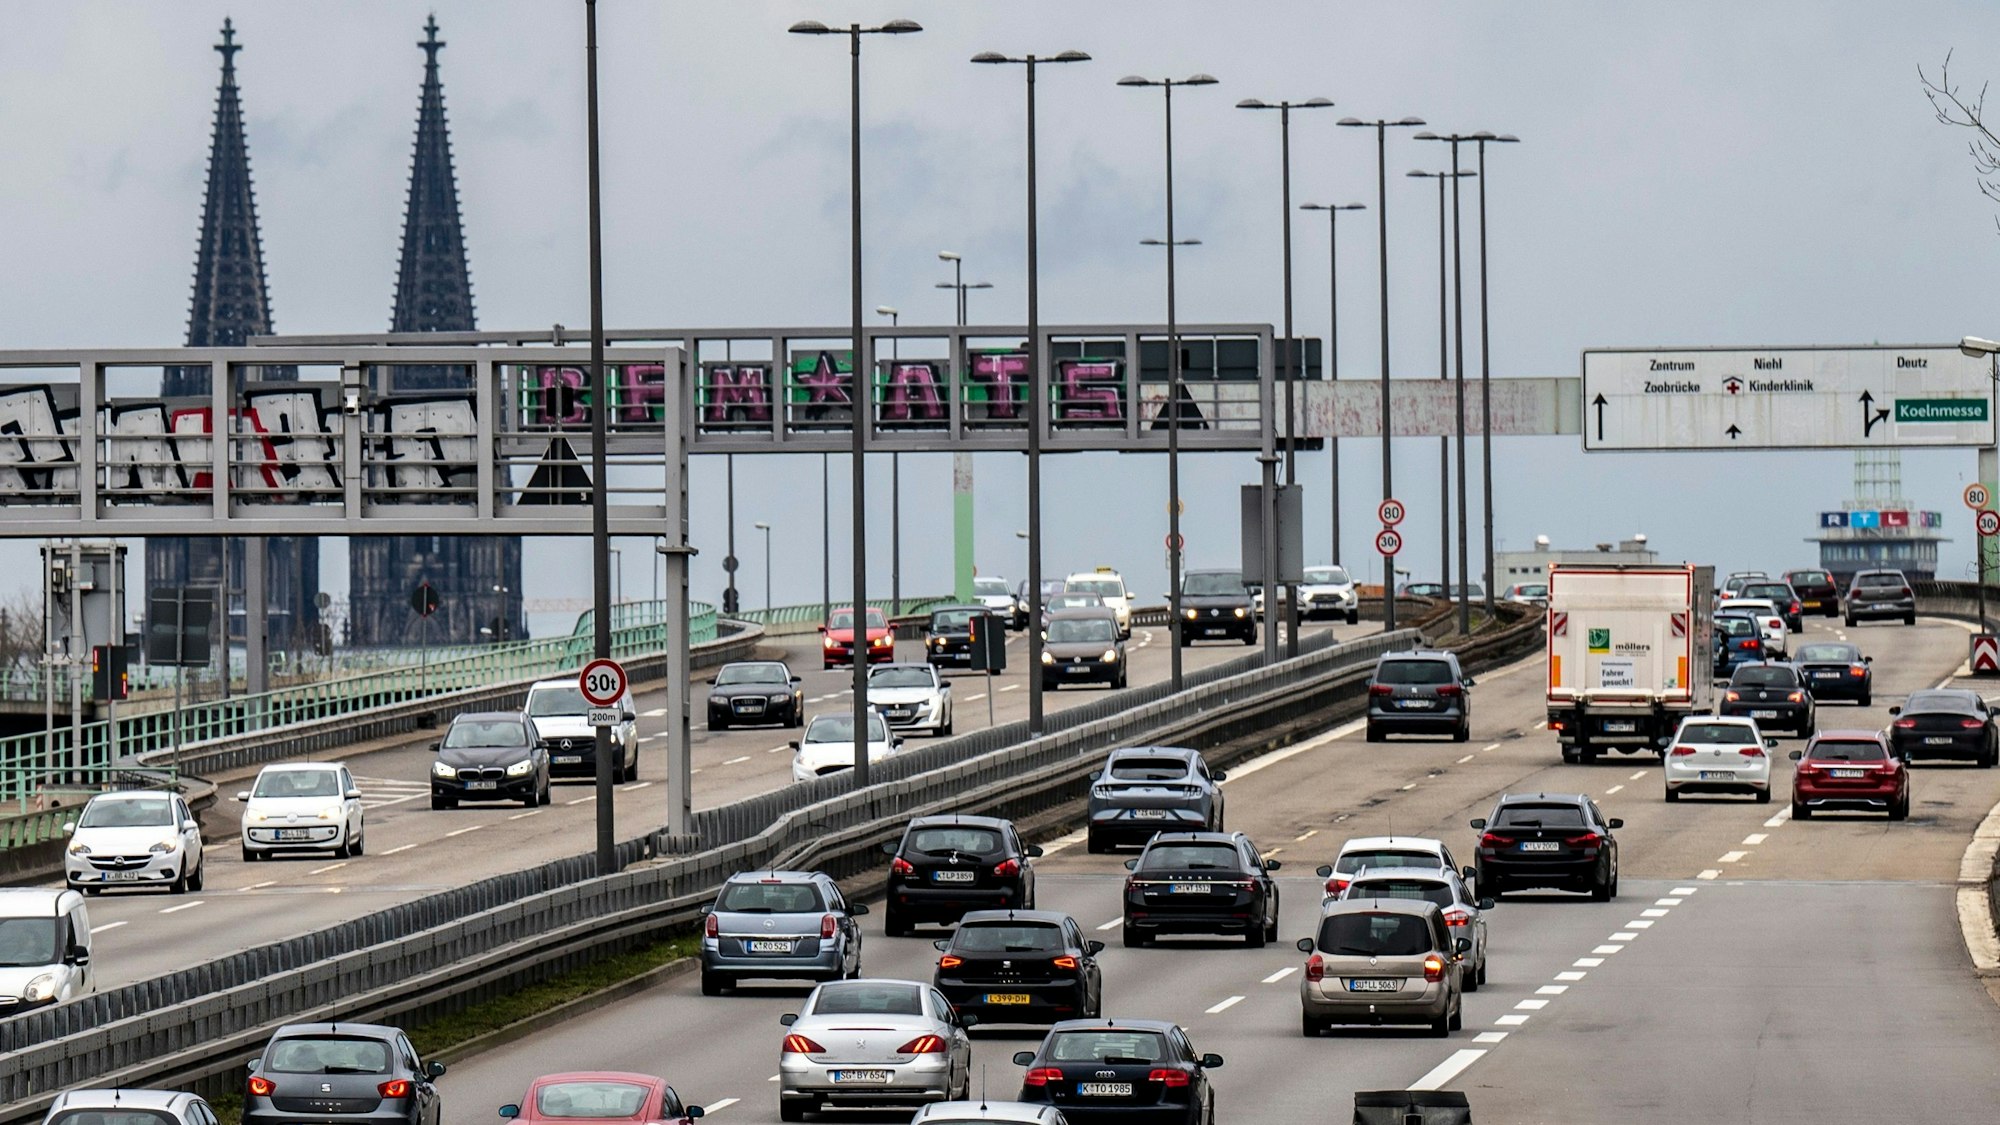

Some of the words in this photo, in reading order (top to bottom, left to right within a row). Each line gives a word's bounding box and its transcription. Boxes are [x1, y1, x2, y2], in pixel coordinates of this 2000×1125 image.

[1650, 359, 1695, 371] Zentrum
[1754, 357, 1782, 370] Niehl
[1897, 356, 1928, 368] Deutz
[1644, 380, 1700, 393] Zoobrücke
[1749, 379, 1814, 392] Kinderklinik
[1900, 403, 1982, 418] Koelnmesse
[1969, 490, 1984, 503] 80
[1384, 506, 1399, 519] 80
[1825, 512, 1903, 526] RTL
[1980, 518, 1996, 529] 30t
[1380, 536, 1397, 547] 30t
[1615, 643, 1650, 651] möllers
[587, 674, 616, 692] 30t
[592, 713, 616, 721] 200m
